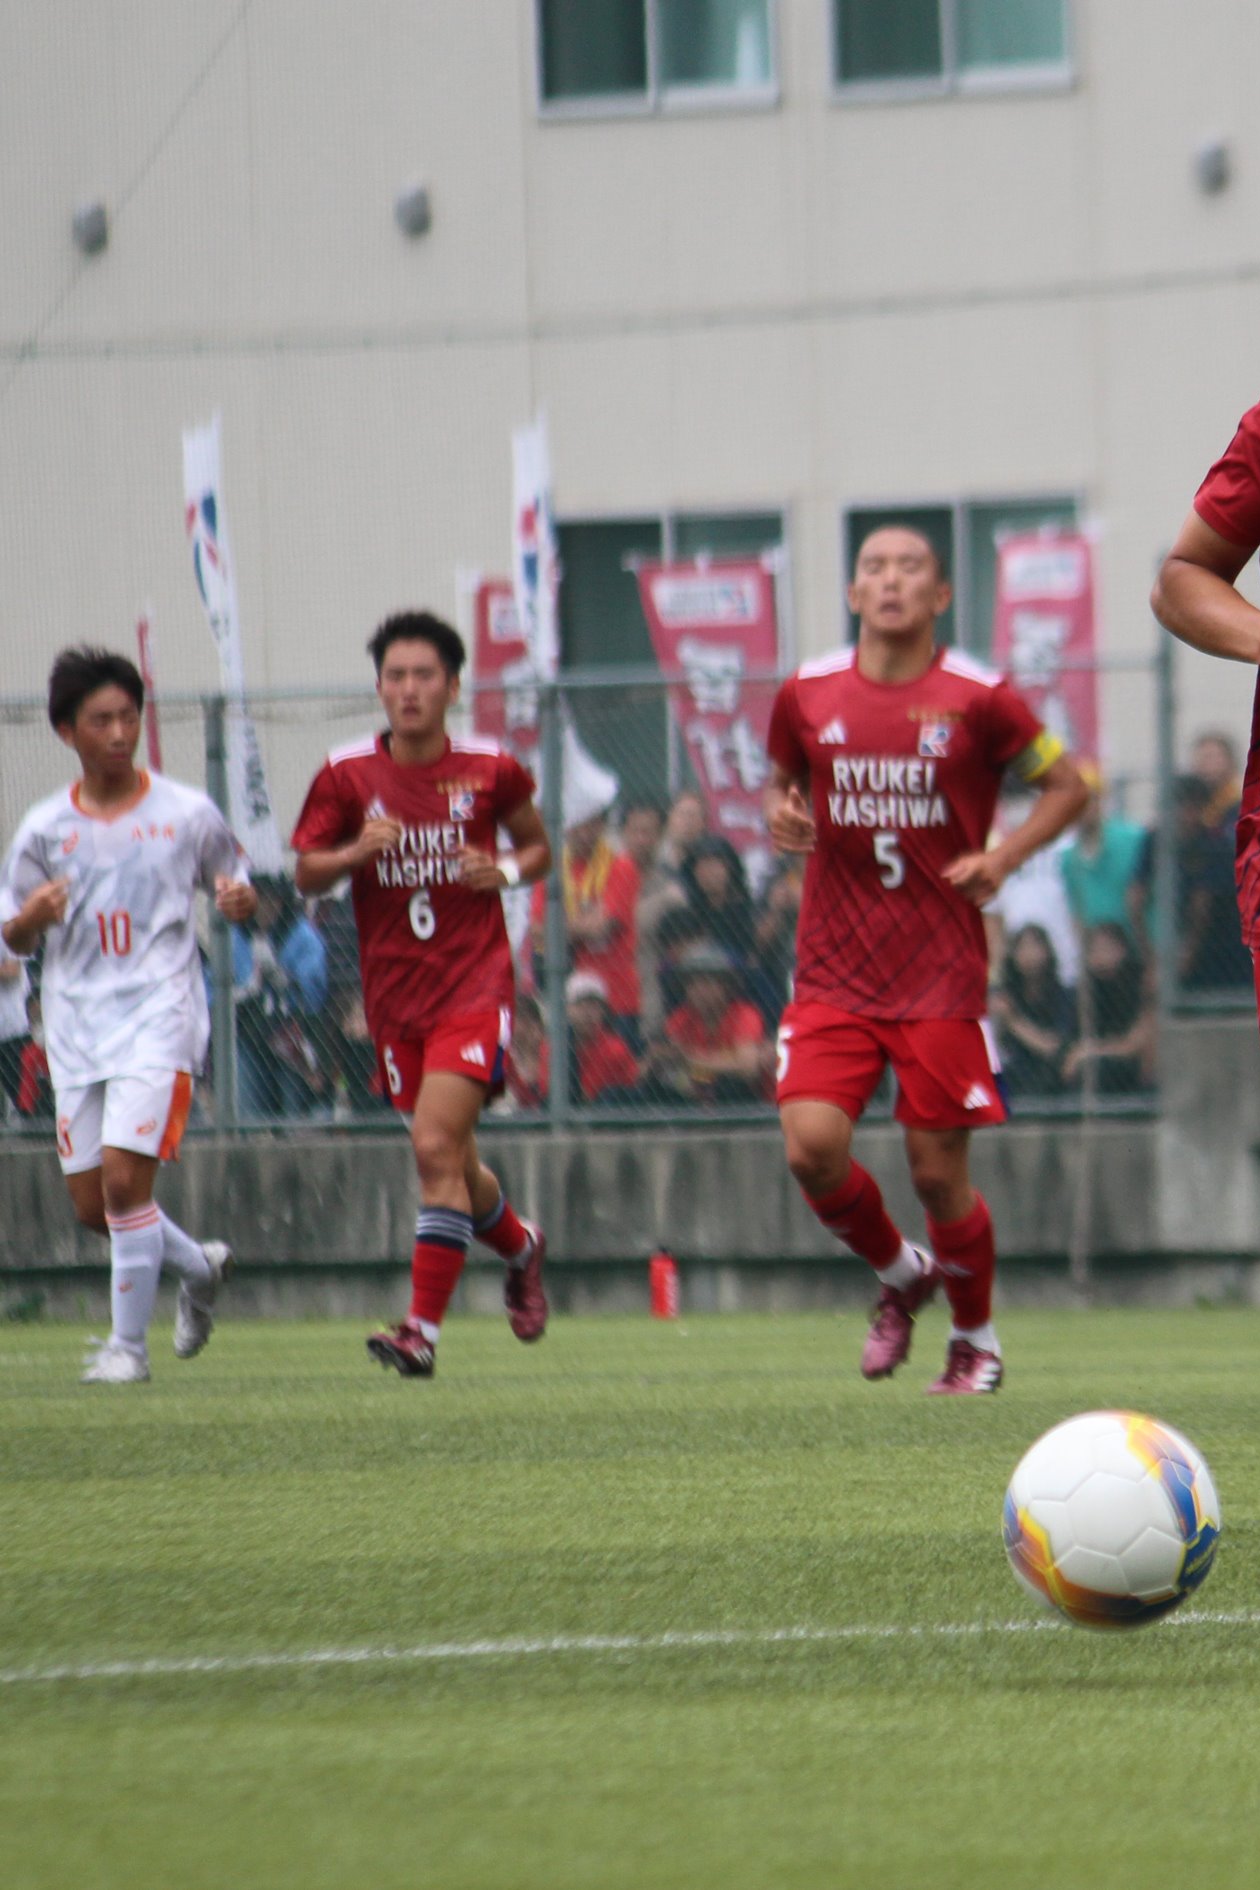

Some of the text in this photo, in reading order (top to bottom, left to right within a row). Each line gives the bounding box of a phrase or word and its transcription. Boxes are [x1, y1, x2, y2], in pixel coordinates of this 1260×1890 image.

[832, 757, 936, 793] RYUKEI
[827, 792, 948, 829] KASHIWA
[382, 820, 466, 858] YUKEI
[375, 856, 462, 889] KASHIW
[872, 831, 905, 889] 5
[97, 909, 132, 957] 10
[408, 889, 436, 941] 6
